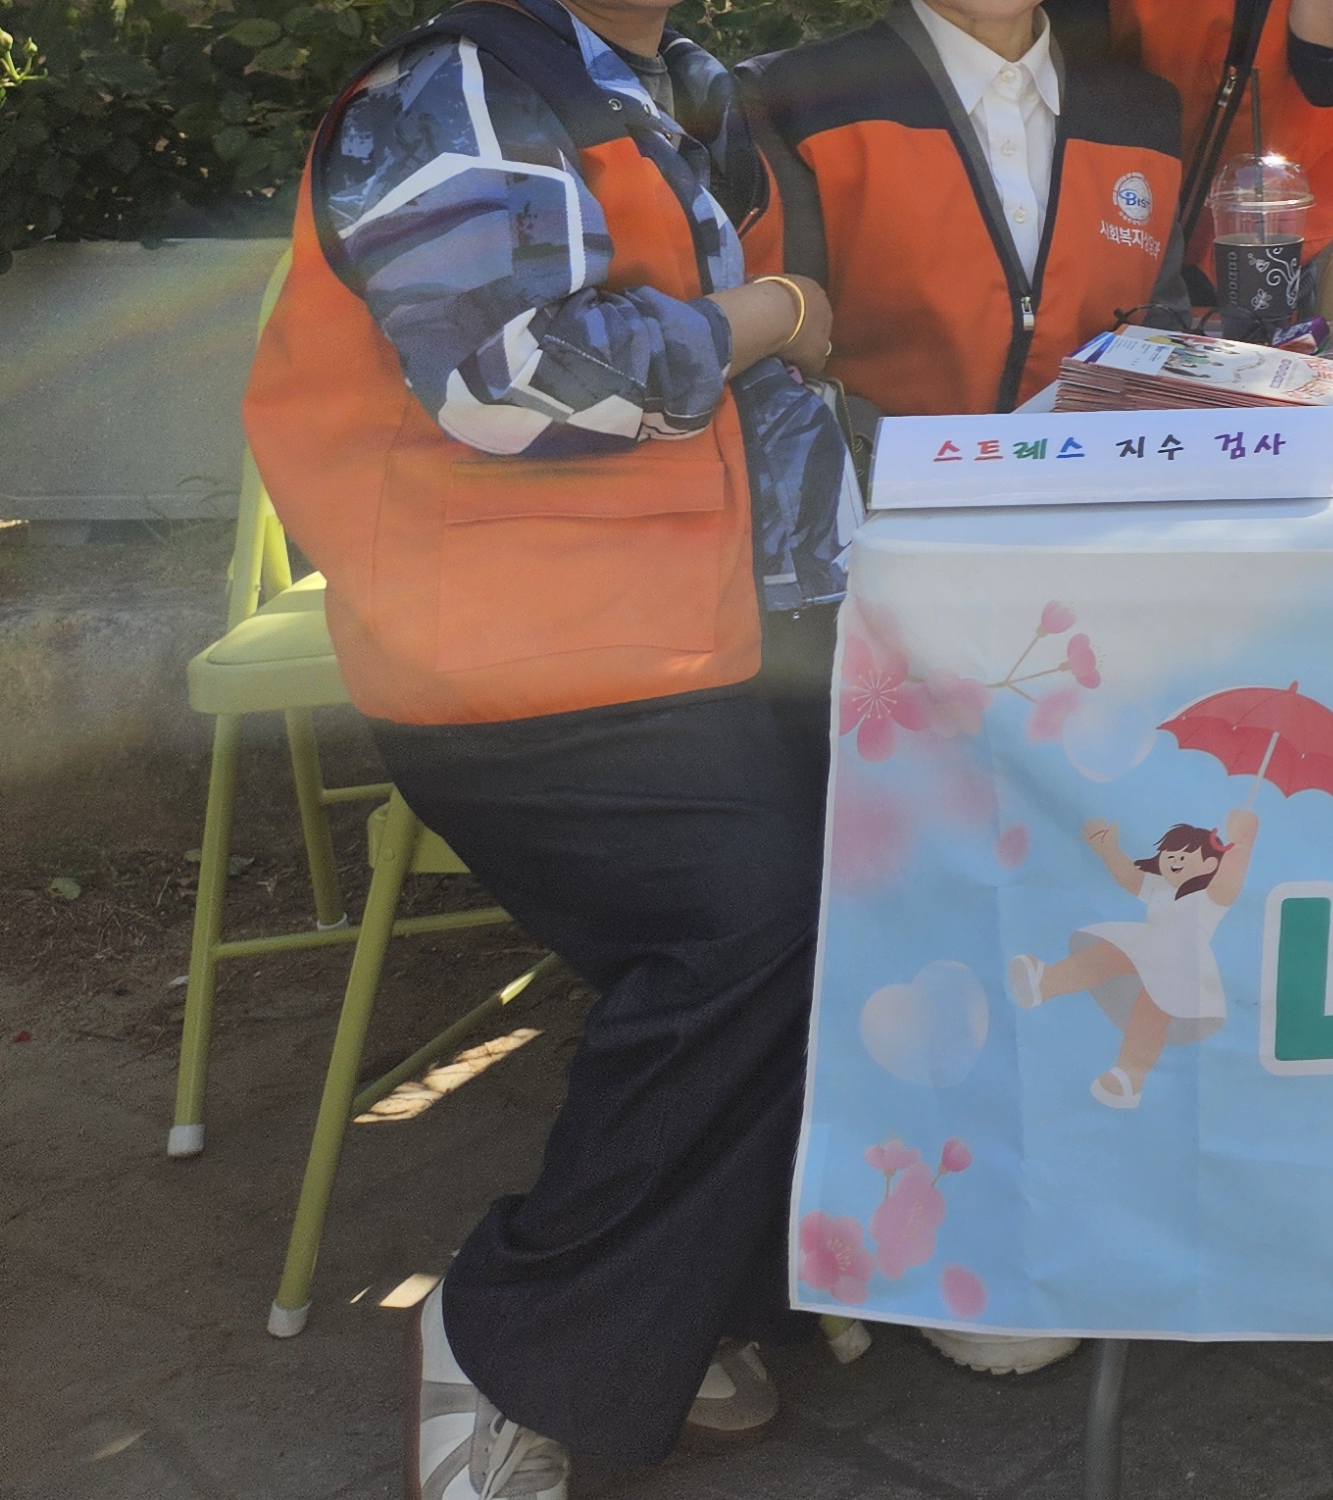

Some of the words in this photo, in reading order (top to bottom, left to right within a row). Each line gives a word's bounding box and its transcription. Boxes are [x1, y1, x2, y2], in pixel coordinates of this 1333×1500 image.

[933, 436, 1086, 464] 스트레스
[1116, 433, 1185, 462] 지수
[1215, 430, 1288, 460] 검사
